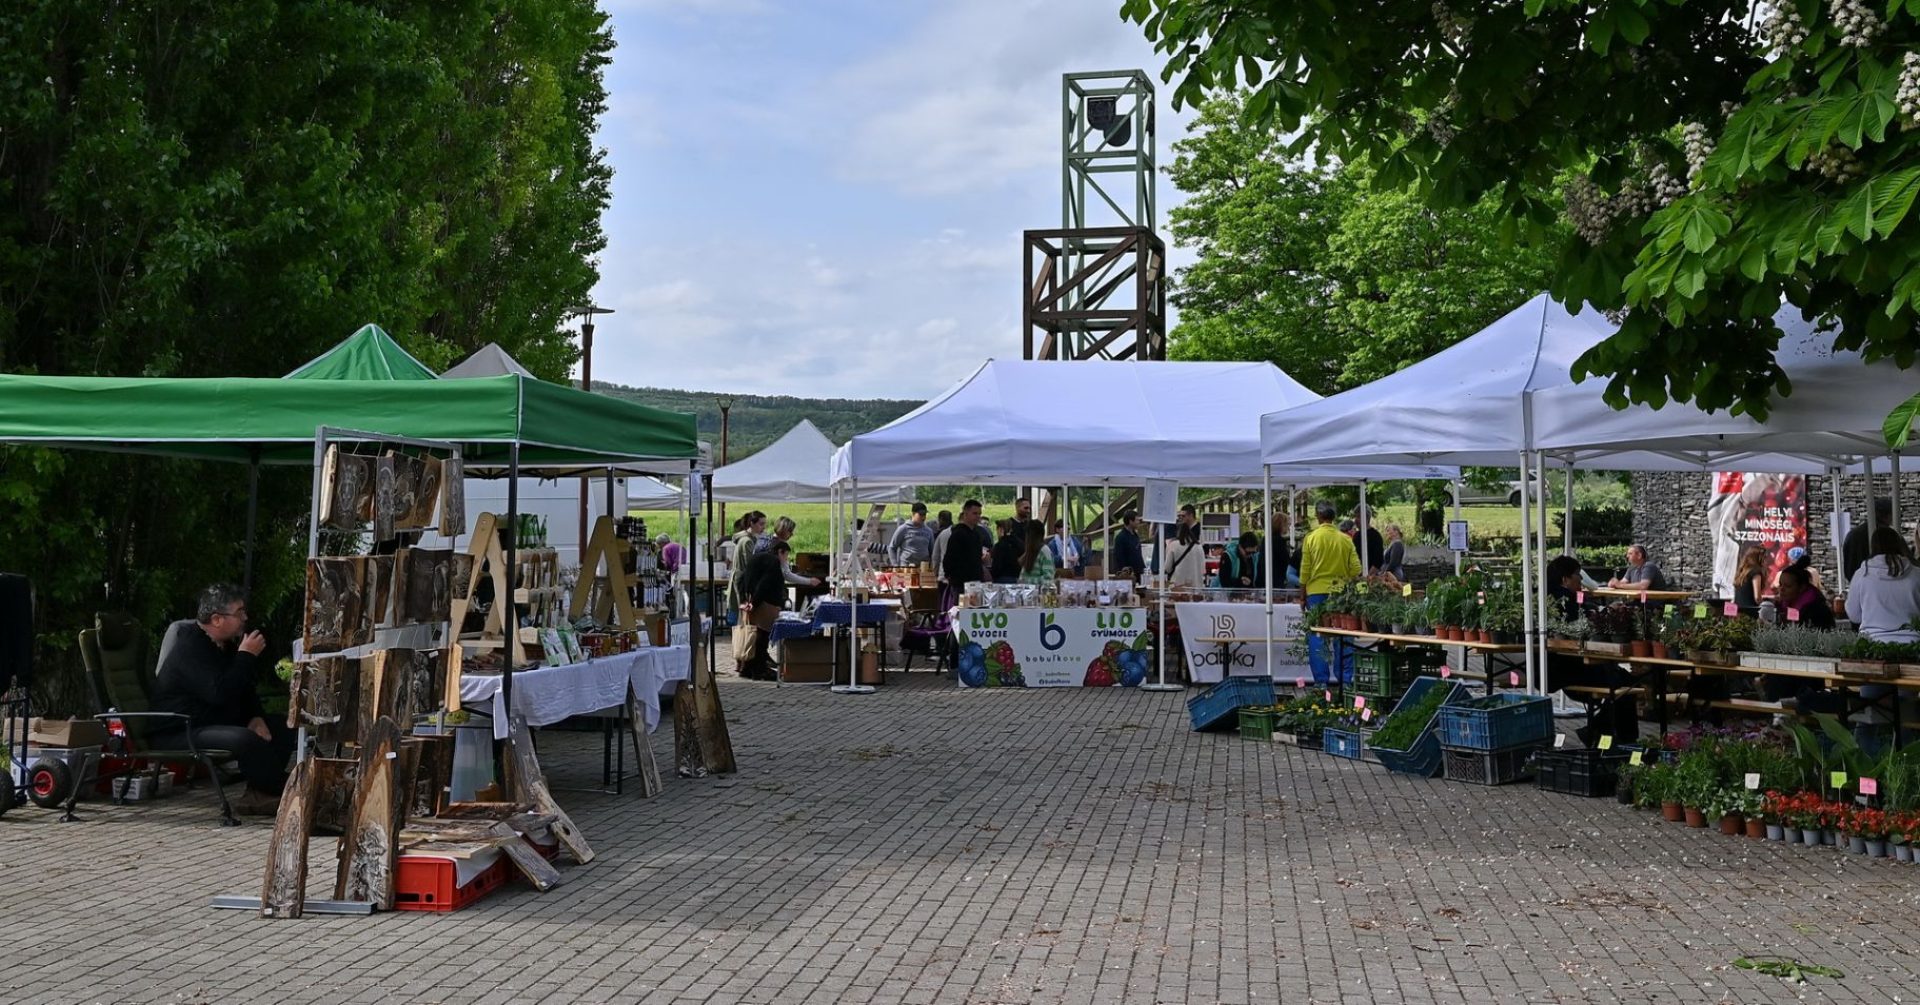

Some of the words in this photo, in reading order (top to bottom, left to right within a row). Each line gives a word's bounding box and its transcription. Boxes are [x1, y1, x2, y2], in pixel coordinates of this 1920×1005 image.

[1735, 531, 1795, 542] SZEZONÁLIS
[971, 612, 1008, 629] LYO
[1097, 612, 1132, 629] LIO
[971, 630, 1008, 638] OVOCIE
[1091, 628, 1138, 637] GYÜMÖLCS
